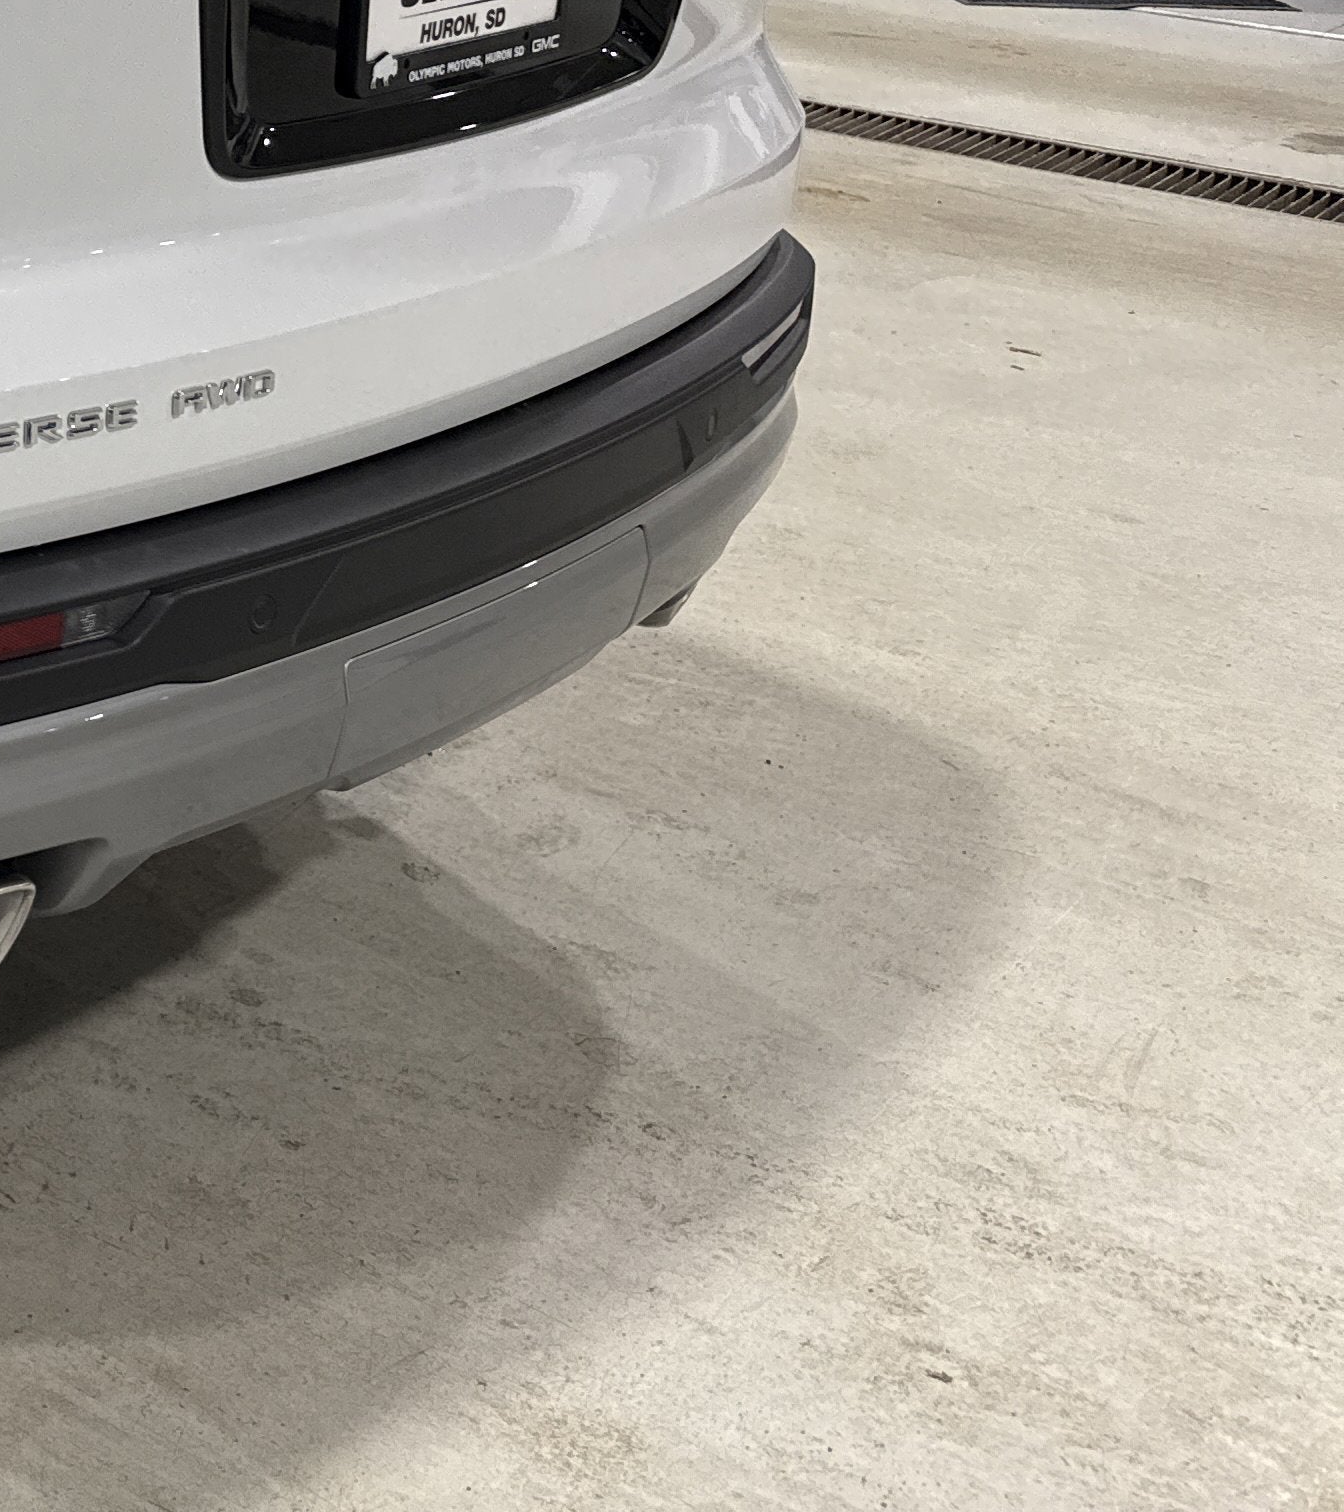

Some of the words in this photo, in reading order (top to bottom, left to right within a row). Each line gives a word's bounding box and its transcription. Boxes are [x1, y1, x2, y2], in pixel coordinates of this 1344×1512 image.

[420, 12, 479, 43] HURON,
[485, 7, 506, 28] SD
[531, 34, 560, 53] GMC
[408, 64, 445, 82] OLYMPIC
[447, 56, 484, 73] MOTORS,
[485, 47, 512, 64] HURON
[513, 45, 525, 57] SD
[171, 369, 276, 419] AWD
